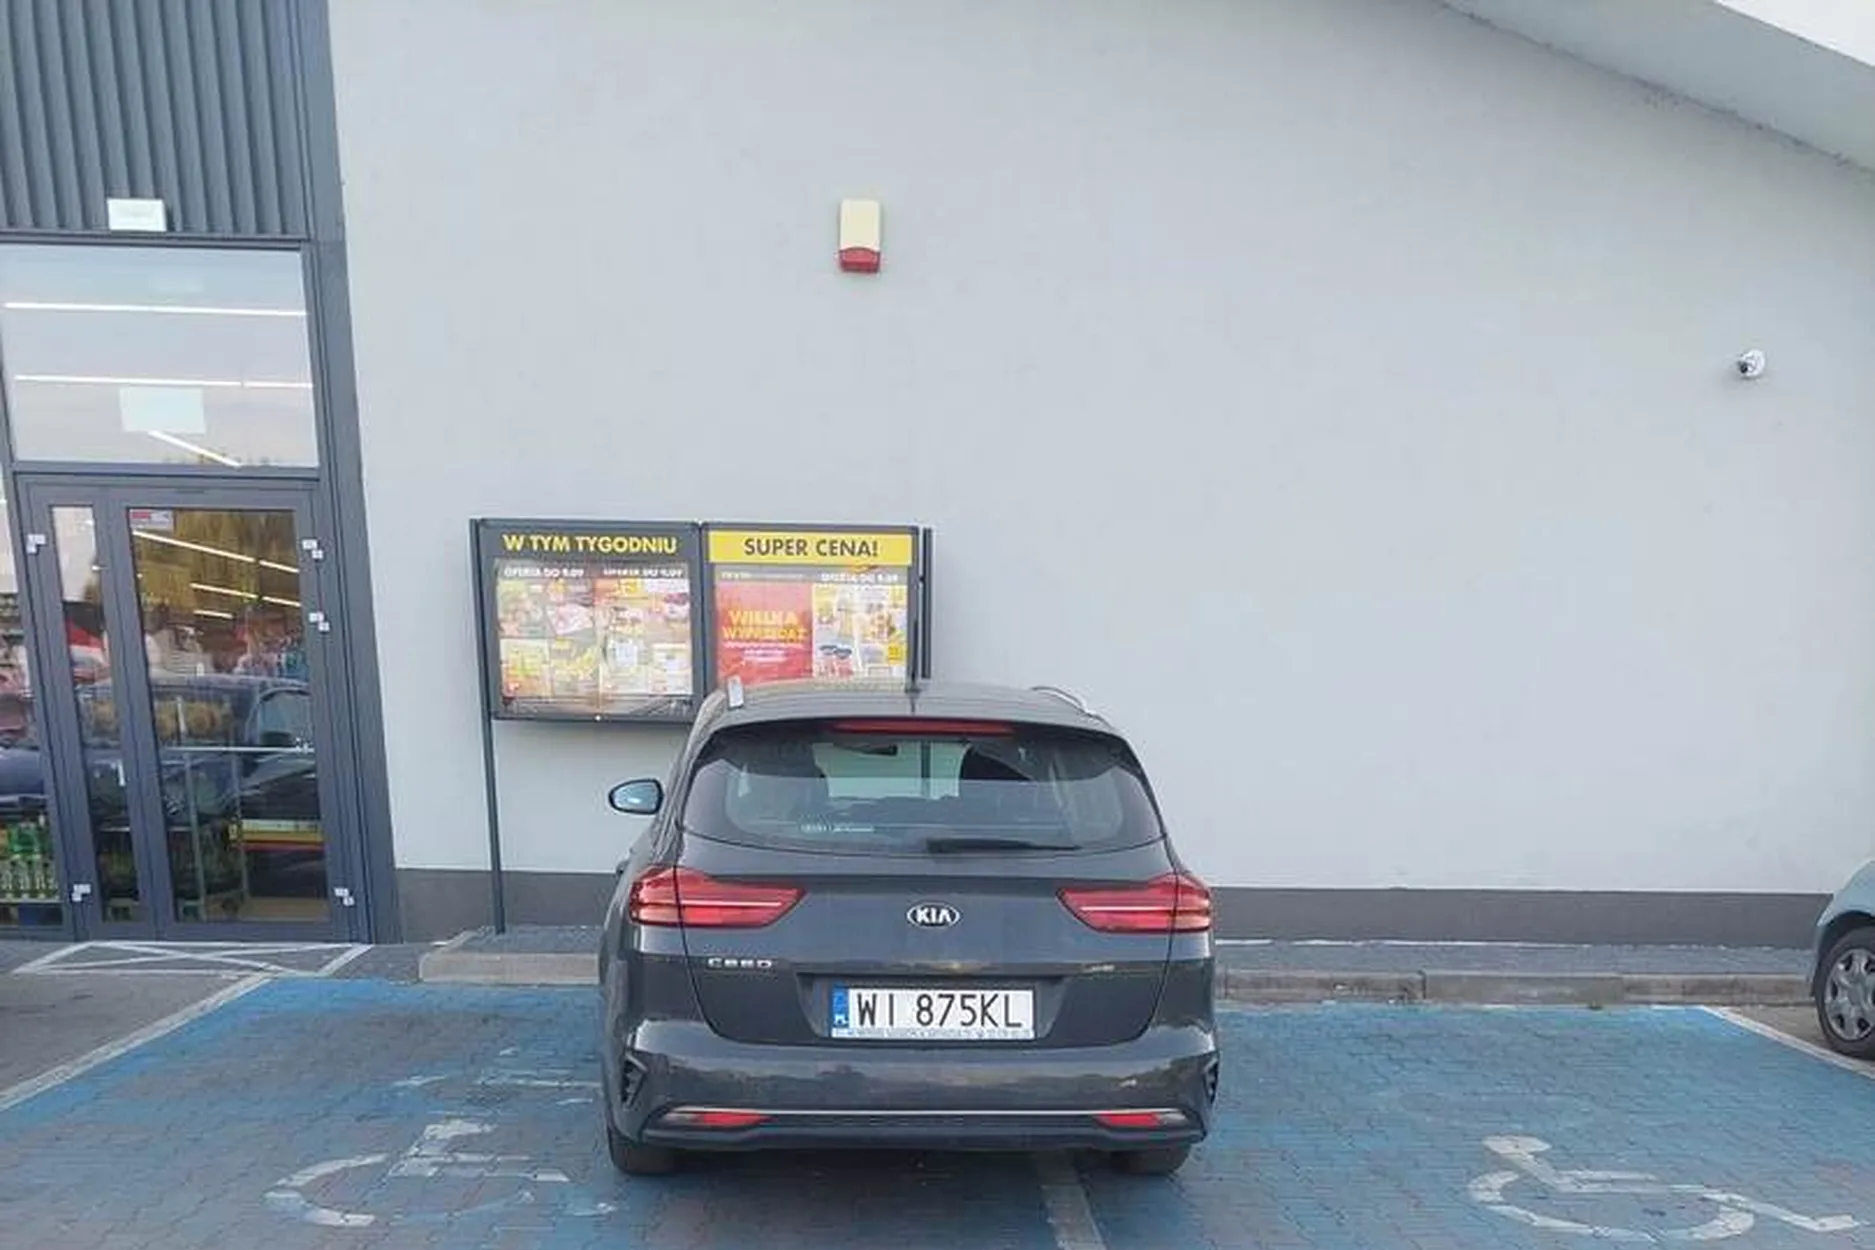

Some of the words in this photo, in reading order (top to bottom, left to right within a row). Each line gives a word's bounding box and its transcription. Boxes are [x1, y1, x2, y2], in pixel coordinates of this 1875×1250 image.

[503, 534, 524, 550] W
[530, 536, 570, 552] TYM
[576, 536, 677, 554] TYGODNIU
[744, 538, 808, 556] SUPER
[816, 539, 878, 557] CENA!
[916, 907, 951, 923] KIA
[857, 993, 893, 1026] WI
[916, 994, 1022, 1027] 875KL
